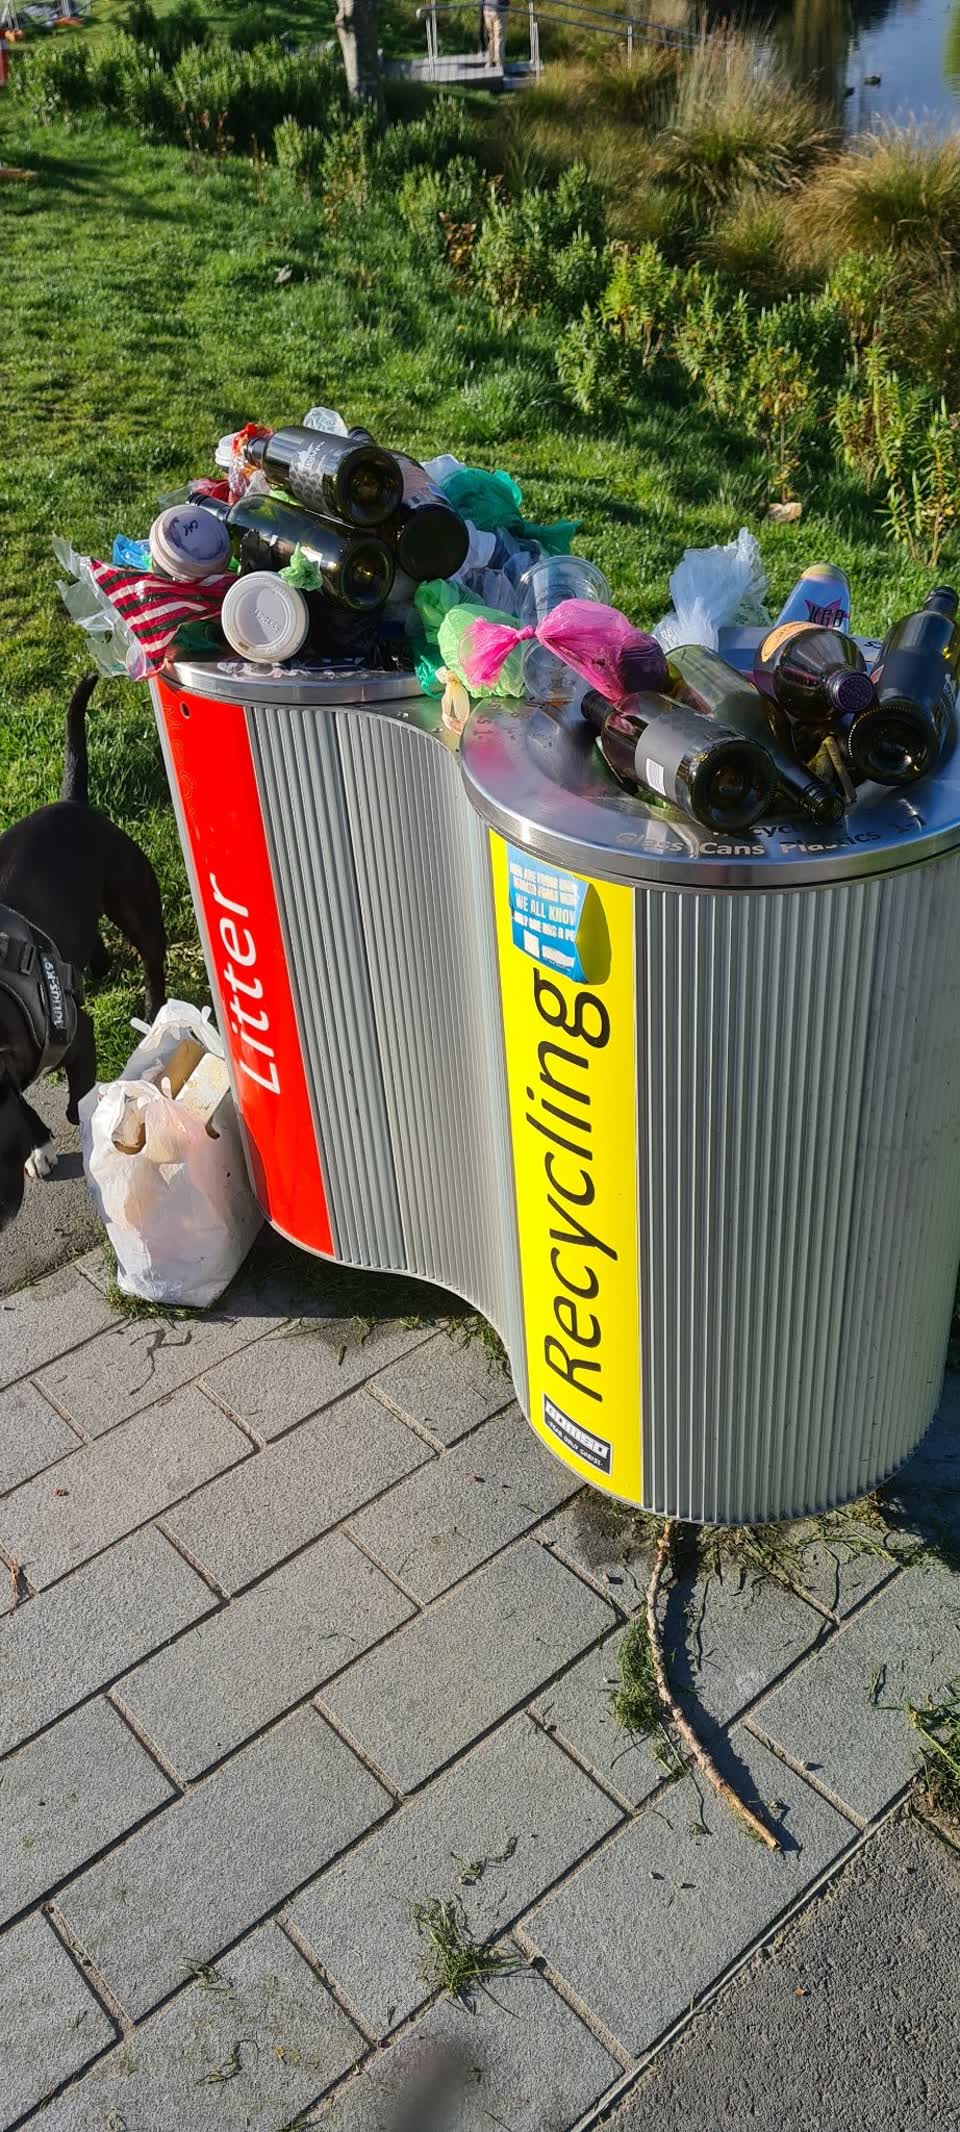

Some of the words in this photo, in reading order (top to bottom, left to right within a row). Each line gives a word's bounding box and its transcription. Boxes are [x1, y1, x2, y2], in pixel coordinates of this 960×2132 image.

[699, 841, 766, 855] Cans
[530, 899, 546, 919] ALL
[208, 872, 281, 1095] Litter
[525, 967, 618, 1403] Recycling
